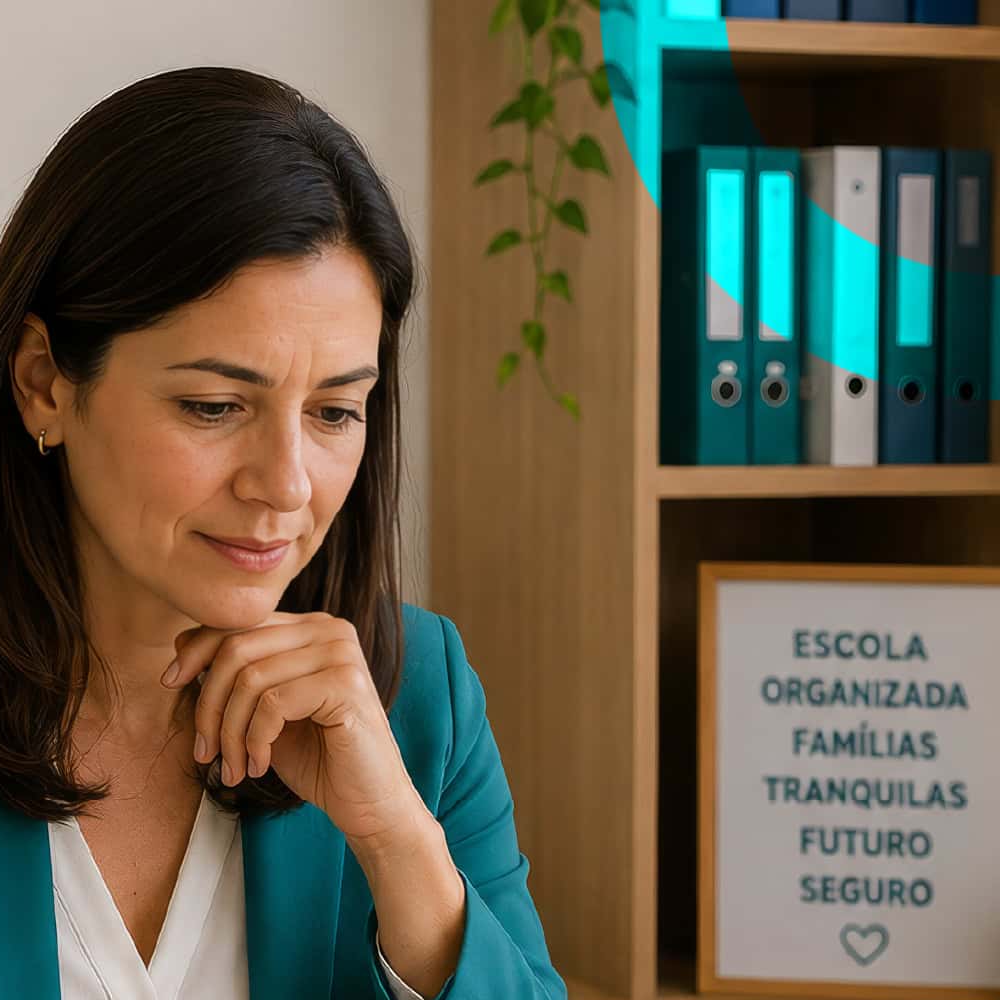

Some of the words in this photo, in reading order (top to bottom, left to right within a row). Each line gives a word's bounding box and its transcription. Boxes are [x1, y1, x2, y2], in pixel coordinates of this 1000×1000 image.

[792, 629, 928, 661] ESCOLA
[760, 675, 968, 710] ORGANIZADA
[792, 720, 937, 760] FAMÍLIAS
[763, 775, 968, 810] TRANQUILAS
[800, 826, 933, 858] FUTURO
[800, 875, 934, 907] SEGURO
